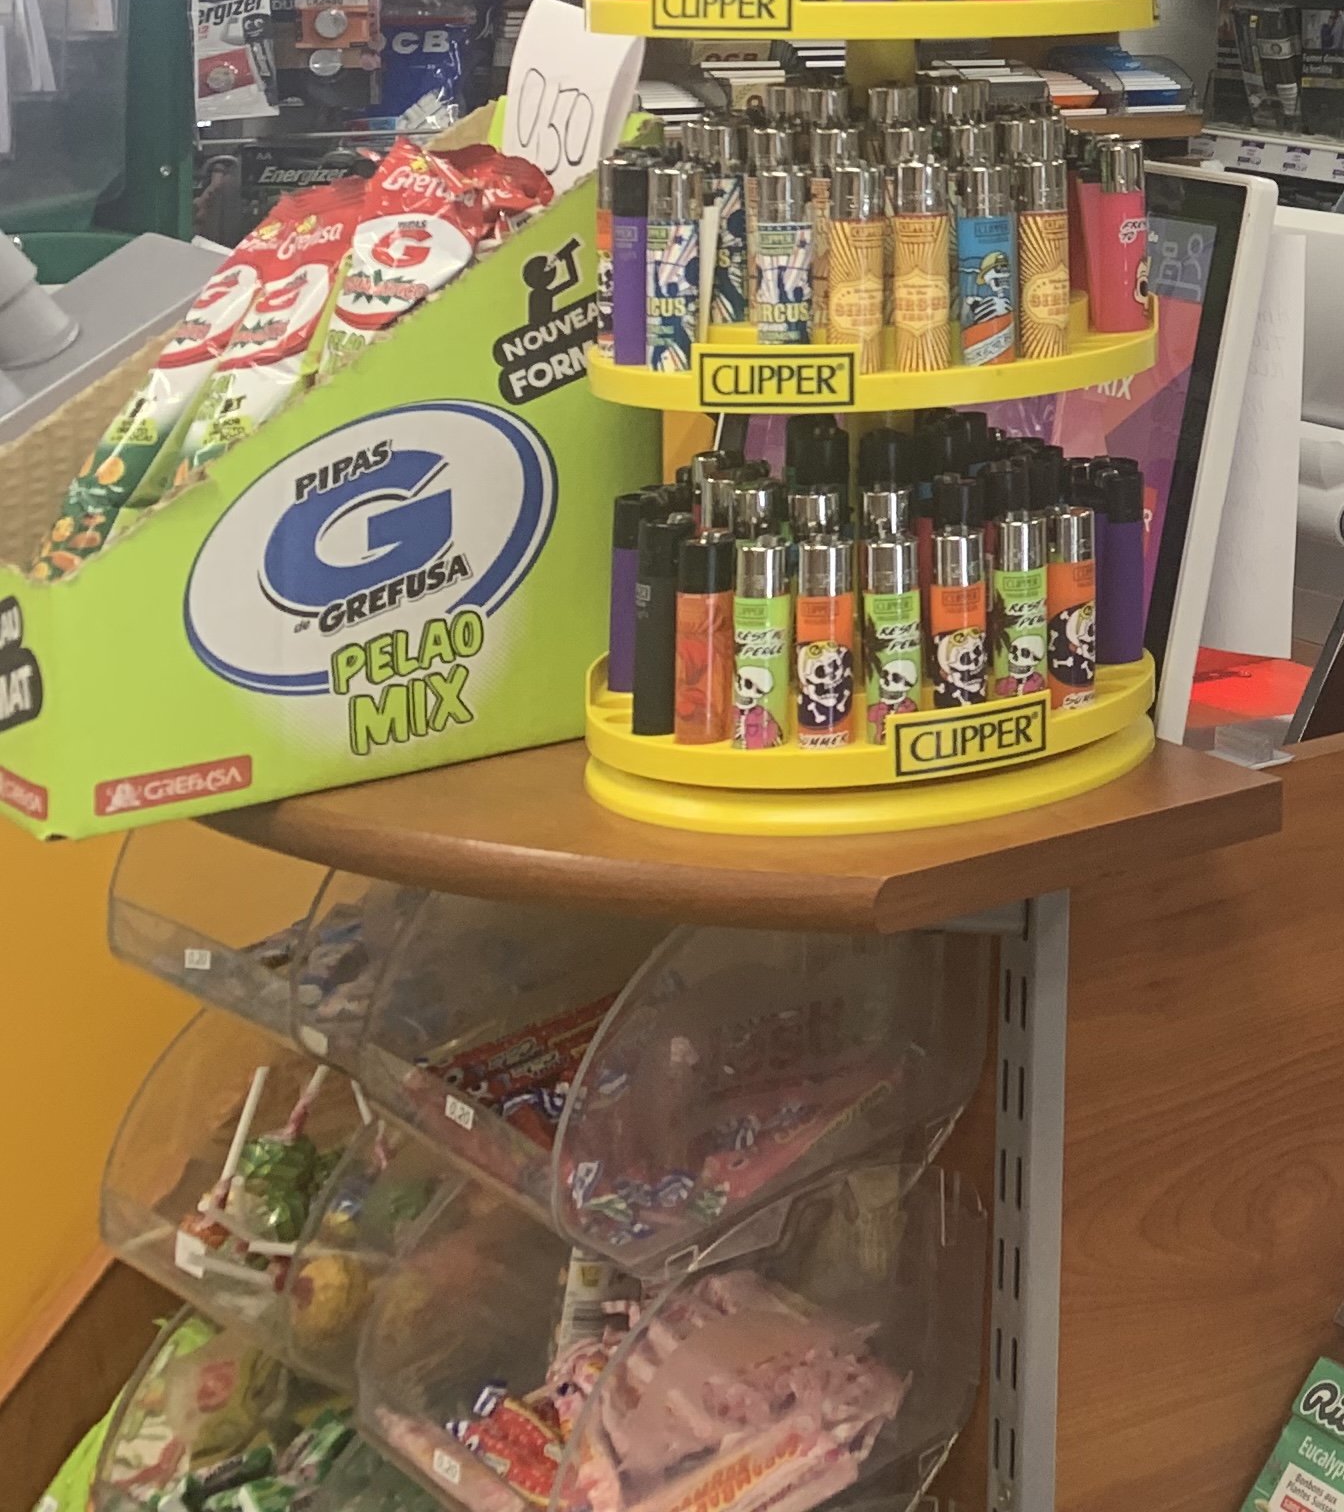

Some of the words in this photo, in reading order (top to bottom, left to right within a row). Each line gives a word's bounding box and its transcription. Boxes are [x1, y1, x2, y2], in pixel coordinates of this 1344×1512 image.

[501, 305, 600, 361] NOUVEA
[711, 363, 838, 398] CLIPPER
[293, 440, 393, 504] PIPAS
[317, 553, 472, 636] GREFUSA
[331, 610, 485, 696] PELAO
[348, 663, 474, 757] MIX
[910, 722, 1033, 763] CLIPPER
[1284, 1482, 1312, 1507] Plantes
[1294, 1472, 1323, 1497] Bonbons
[1324, 1488, 1337, 1505] aux
